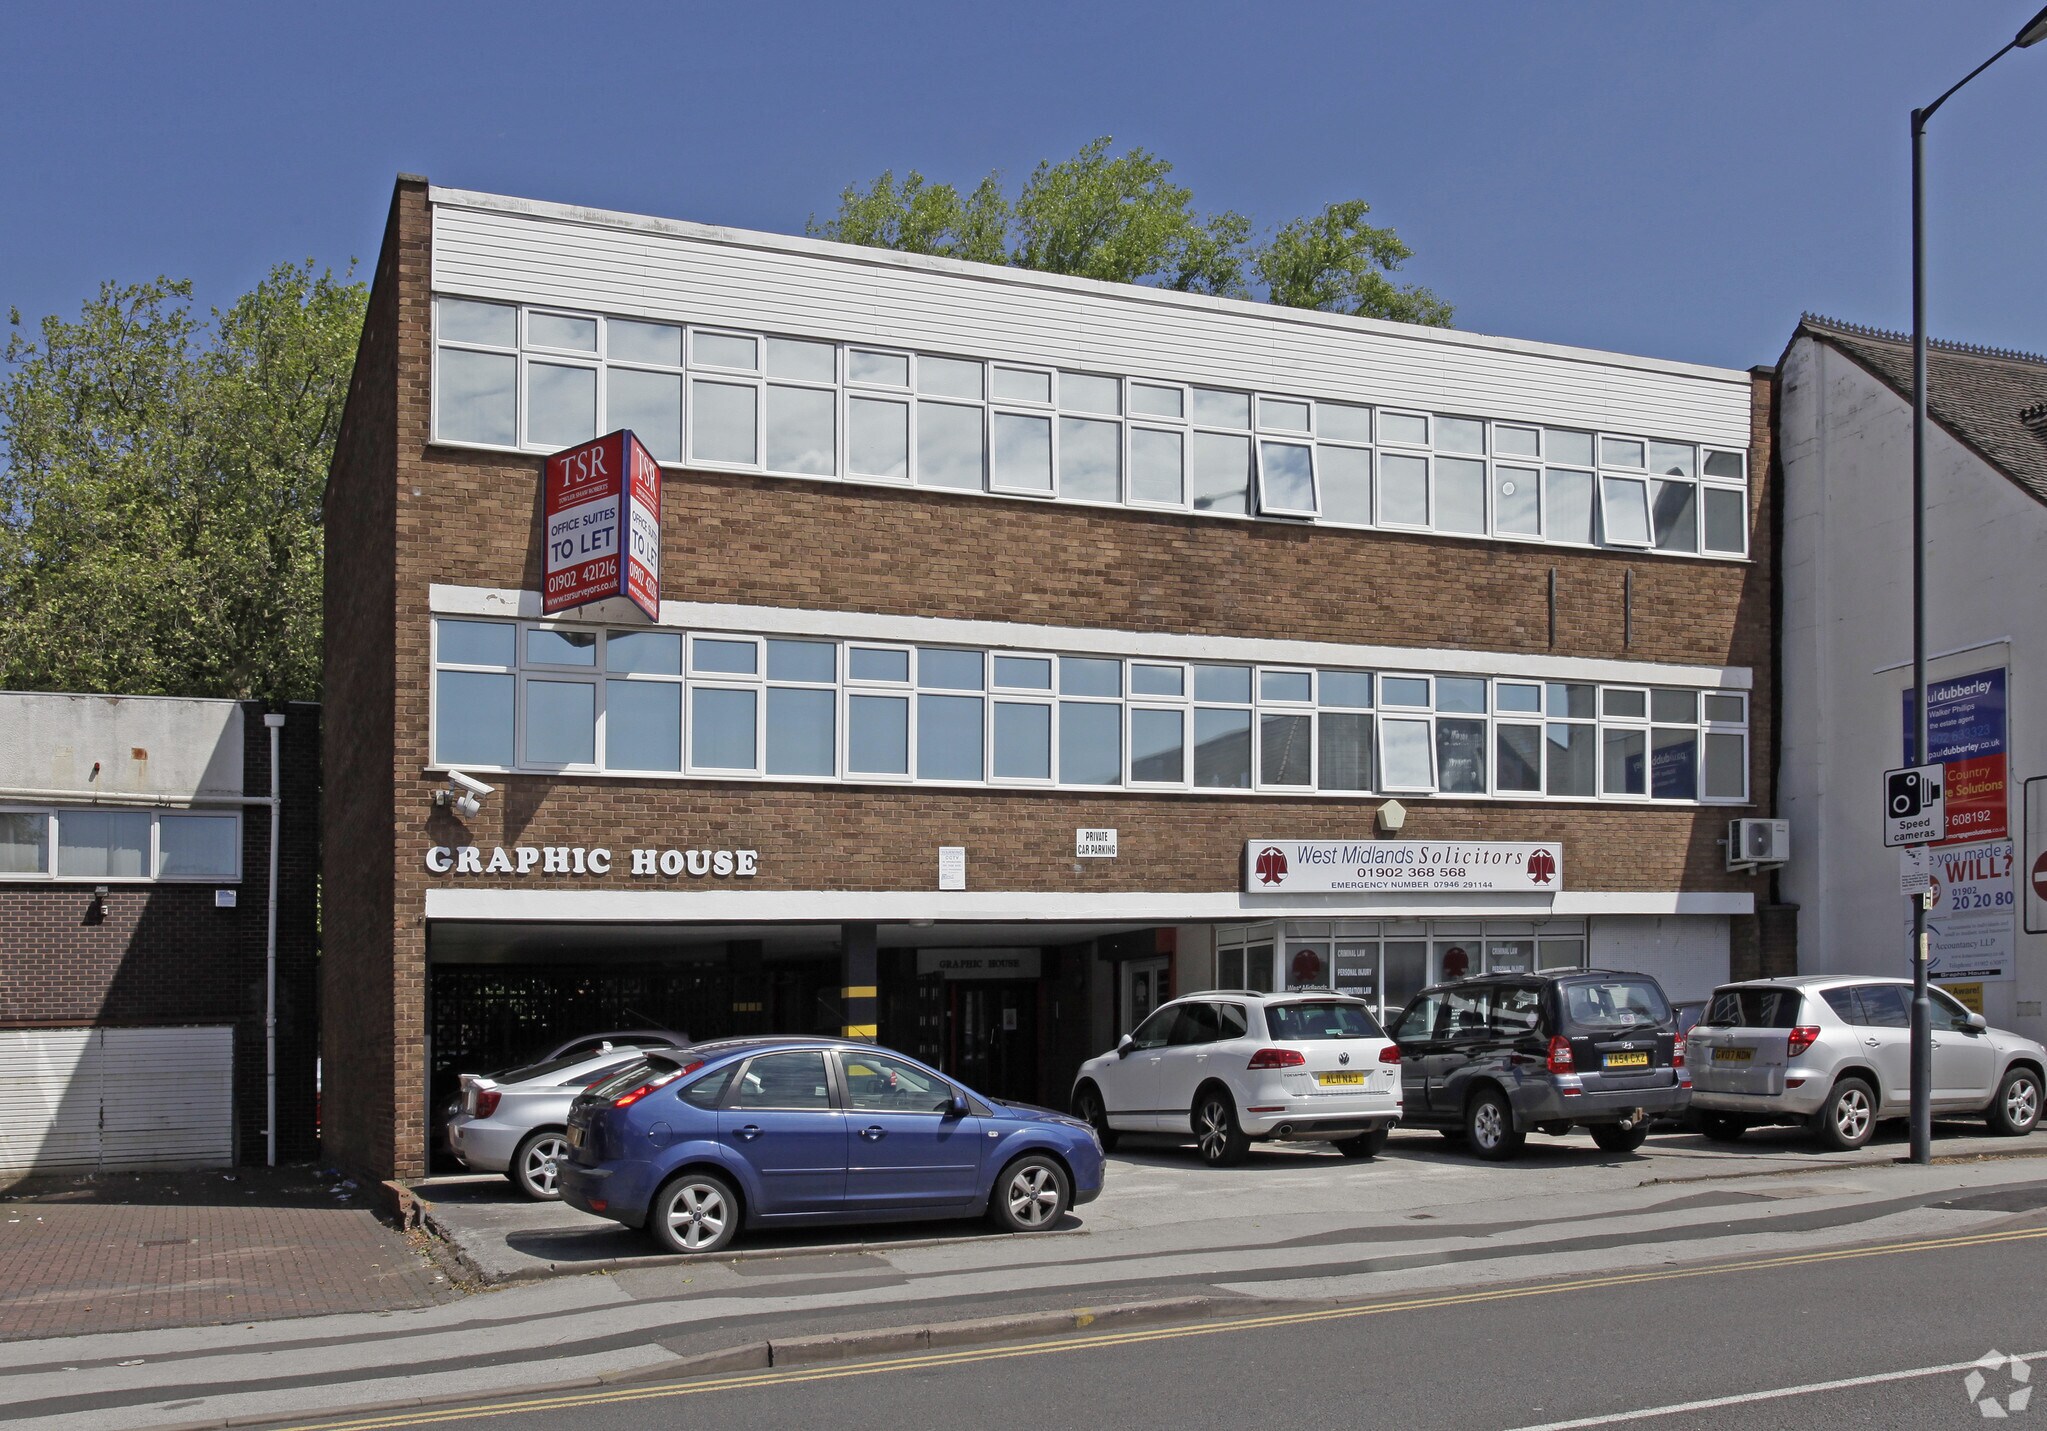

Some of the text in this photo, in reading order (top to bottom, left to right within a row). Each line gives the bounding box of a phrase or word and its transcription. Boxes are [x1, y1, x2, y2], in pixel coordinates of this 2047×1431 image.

[560, 446, 608, 487] TSR
[636, 447, 657, 498] TSR
[551, 507, 616, 536] OFFICE SUITES
[632, 510, 648, 533] OFFICE
[551, 526, 614, 562] TO LET
[632, 528, 657, 571] TO LET
[548, 559, 617, 593] 01902 421216
[1927, 681, 1992, 703] uldubberley
[1928, 703, 1975, 718] Walker Phillips
[1940, 718, 1957, 728] estate
[1958, 715, 1975, 725] agent
[1948, 767, 1991, 782] Country
[1956, 780, 2004, 797] Solutions
[1899, 818, 1931, 831] Speed
[1953, 809, 1991, 826] 608192
[1085, 831, 1108, 841] PRIVATE
[1894, 829, 1936, 842] cameras
[1078, 844, 1116, 855] CAR PARKING
[1297, 845, 1523, 864] West Midlands Solicitors
[1937, 852, 1961, 868] you
[1964, 844, 2001, 860] made
[2005, 845, 2012, 855] a
[426, 846, 758, 875] GRAPHIC HOUSE
[1357, 867, 1466, 878] 01902 368 568
[1945, 854, 2014, 883] WILL?
[1331, 881, 1389, 889] EMERGENCY
[1952, 886, 1977, 896] 01902
[1952, 891, 2014, 910] 20 20 80
[1935, 940, 1978, 951] Accountancy
[1980, 938, 1996, 947] LLP
[939, 959, 1021, 969] GRAPHIC HOUSE
[1337, 968, 1357, 976] PERSONAL
[1952, 985, 1980, 995] Aware!
[1630, 1053, 1646, 1063] CXZ
[1342, 1074, 1358, 1083] NAJ
